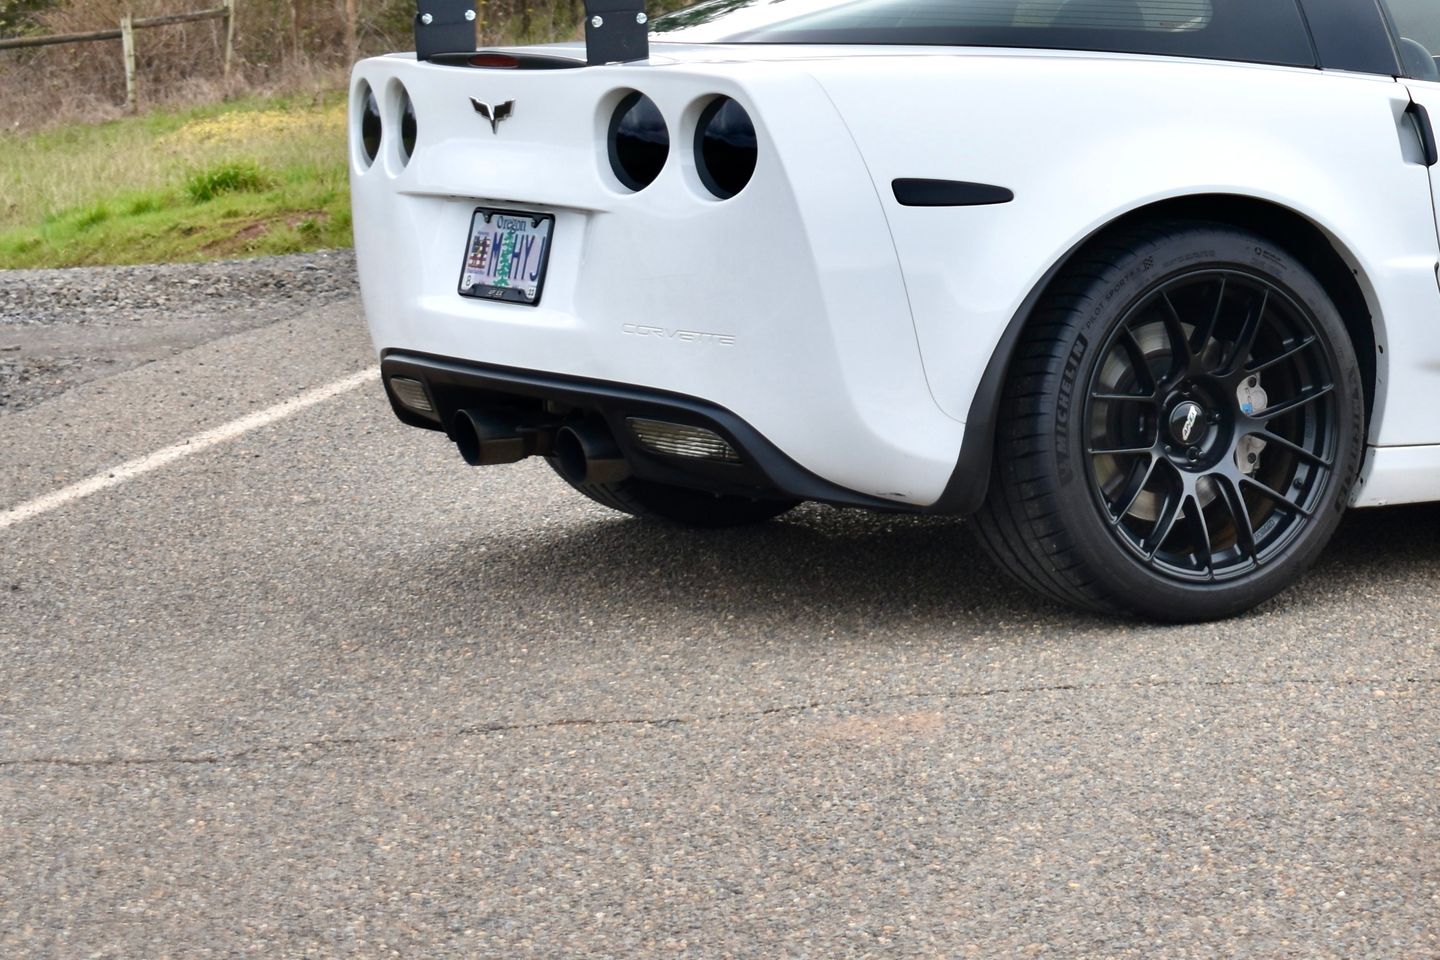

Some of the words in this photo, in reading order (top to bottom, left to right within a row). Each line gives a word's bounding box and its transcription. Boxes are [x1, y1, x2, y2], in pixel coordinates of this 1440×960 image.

[496, 216, 526, 235] Oregon
[622, 323, 736, 346] CORVETTE
[1055, 339, 1085, 456] MICHELIN
